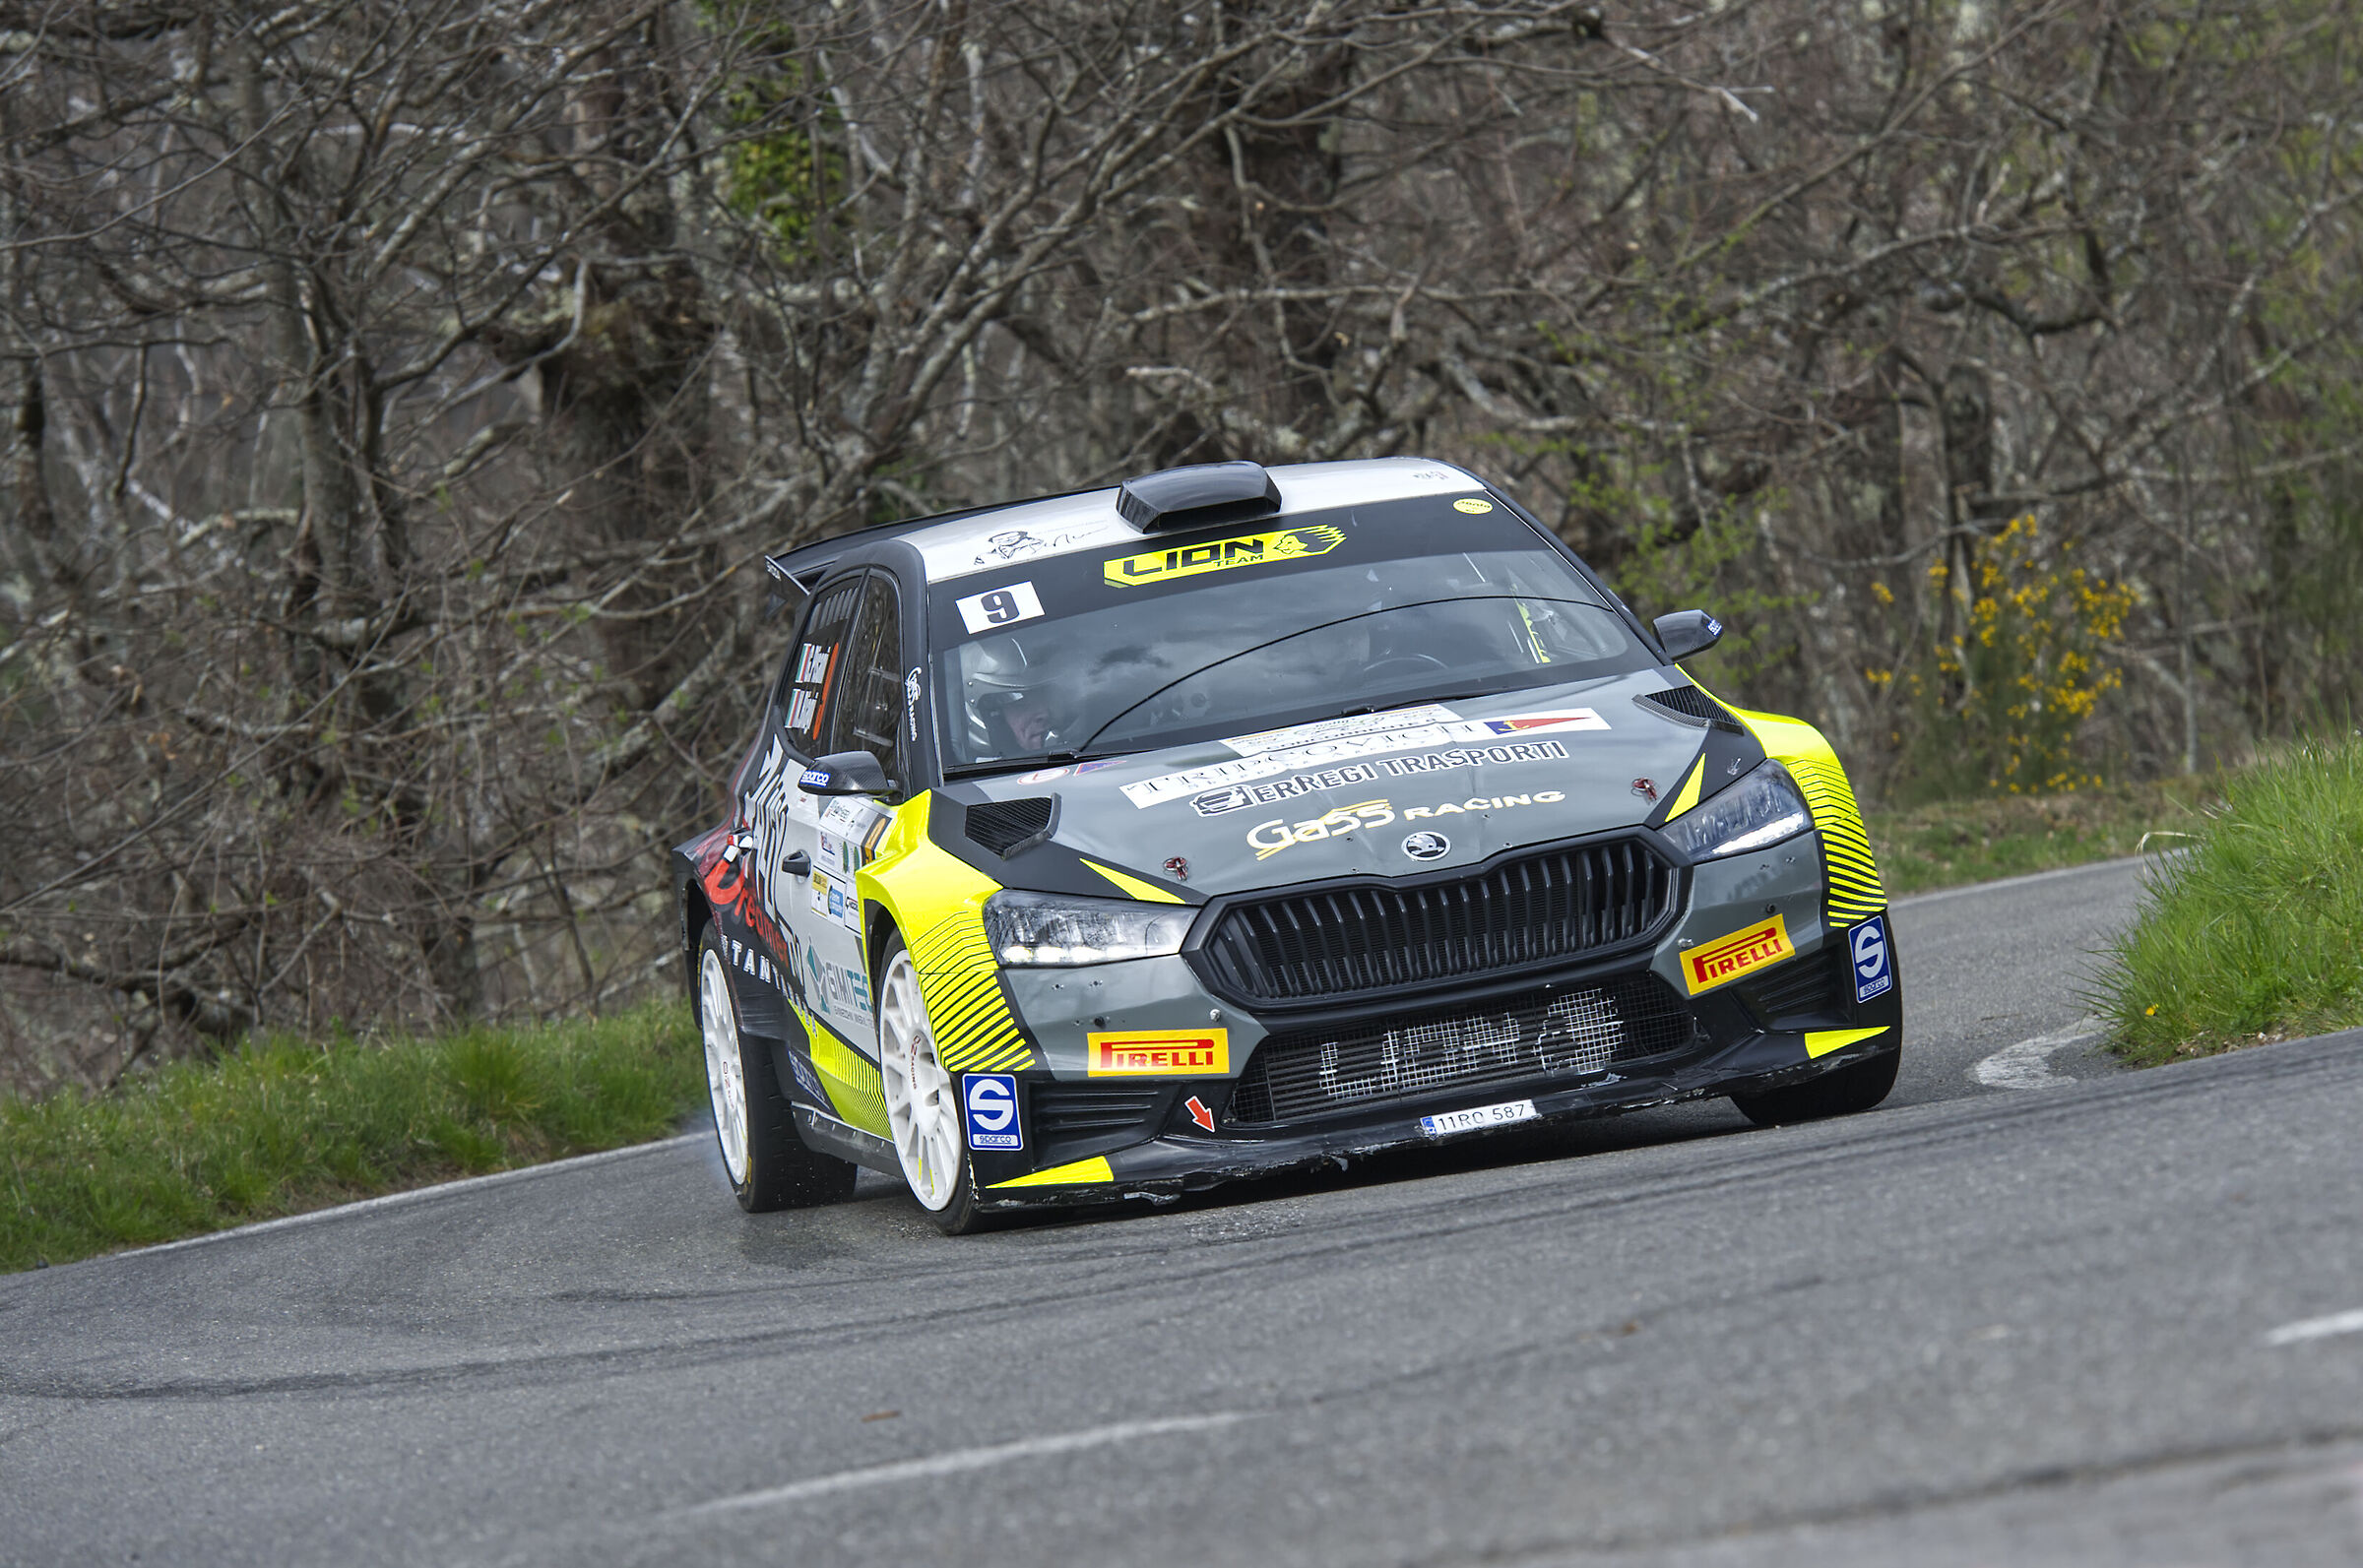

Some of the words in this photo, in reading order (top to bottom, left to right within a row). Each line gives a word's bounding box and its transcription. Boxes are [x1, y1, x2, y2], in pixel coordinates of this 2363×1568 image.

[1123, 538, 1263, 577] LION
[1213, 554, 1263, 568] TEAM
[981, 591, 1020, 624] 9
[1125, 722, 1476, 796] TRIPCOVICH
[1252, 763, 1377, 805] ERREGI
[1377, 741, 1568, 776] TRASPORTI
[801, 771, 829, 784] sparco
[1403, 789, 1565, 821] RACING
[1692, 927, 1783, 984] PIRELLI
[1100, 1038, 1215, 1069] PIRELLI
[1492, 1103, 1526, 1121] 587
[979, 1134, 1012, 1145] sparco
